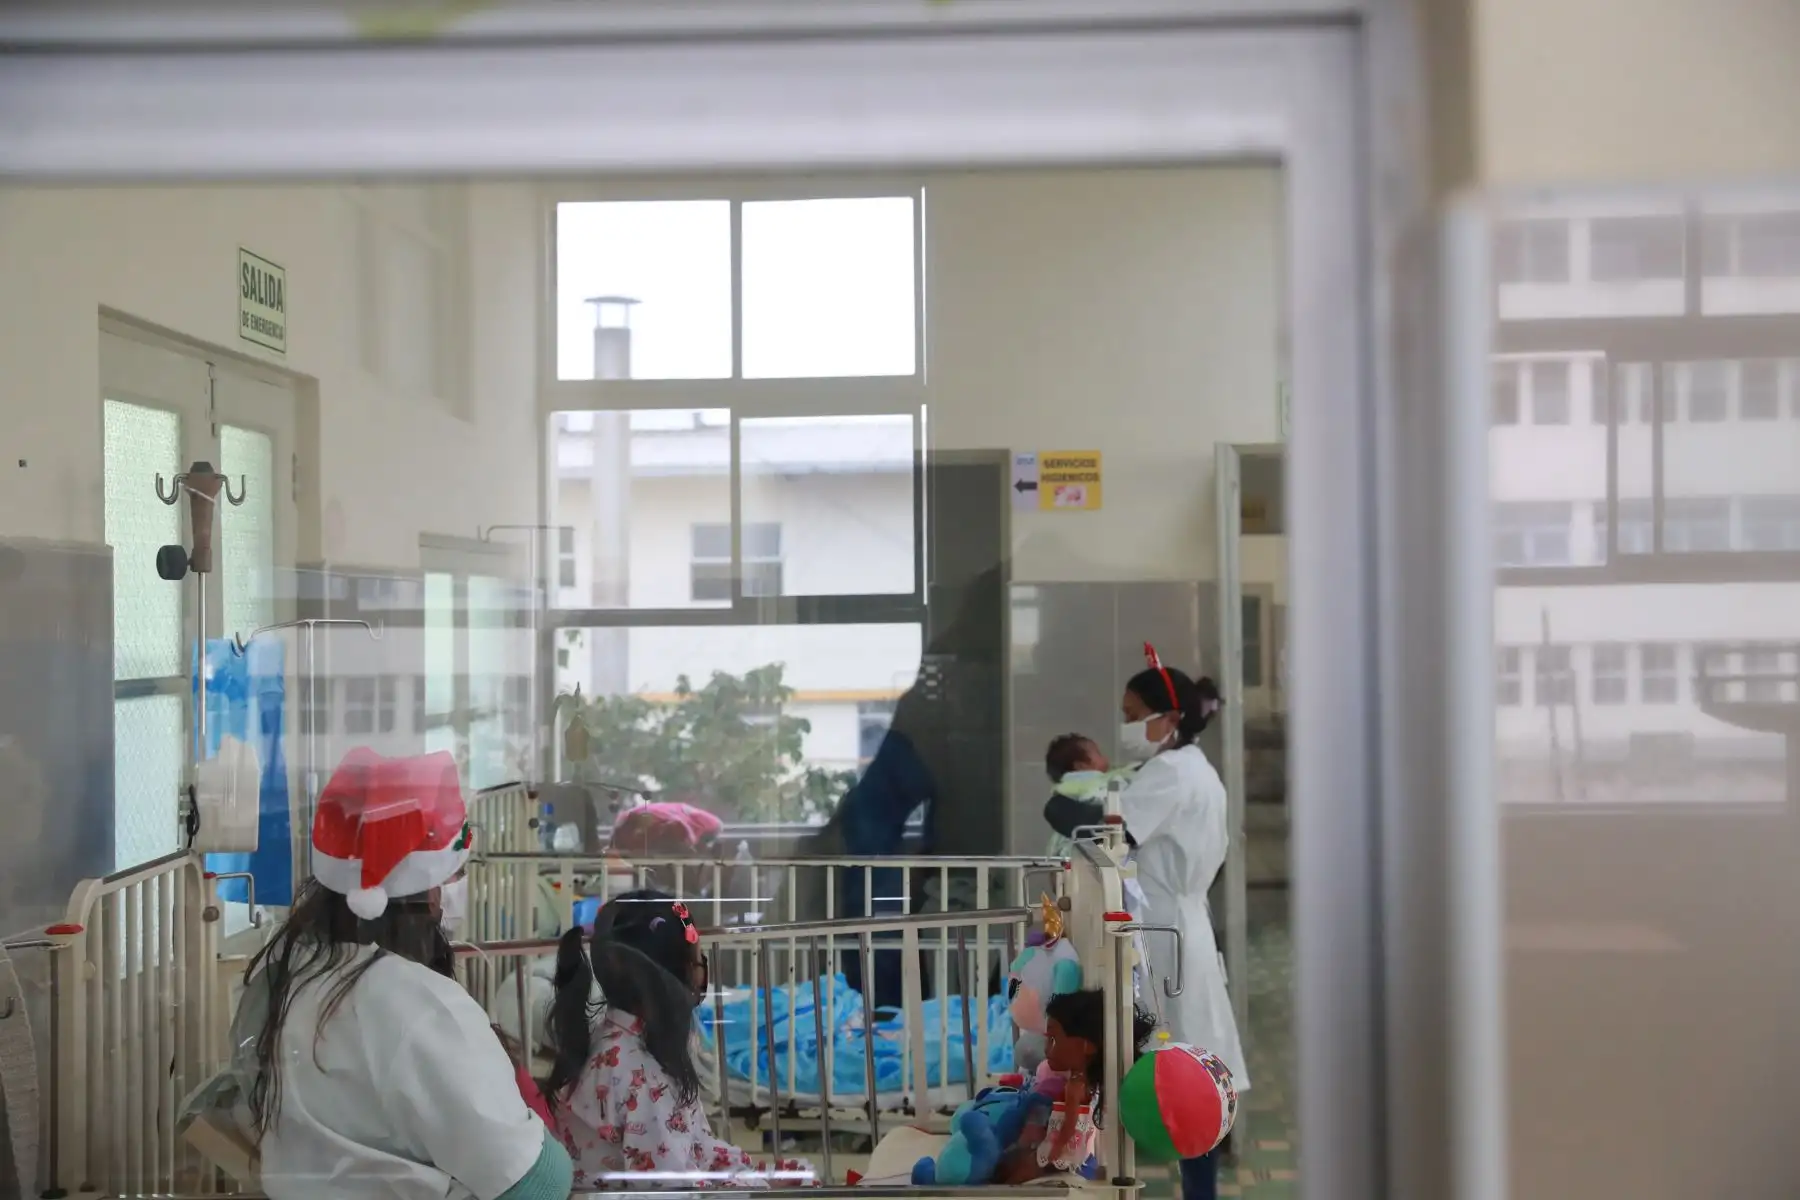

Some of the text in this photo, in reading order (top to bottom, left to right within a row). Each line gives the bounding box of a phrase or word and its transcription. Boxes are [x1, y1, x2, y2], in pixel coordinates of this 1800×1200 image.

[242, 261, 284, 314] SALIDA
[242, 310, 284, 341] DE EMERGENCIA
[1044, 458, 1097, 469] SERVICIOS
